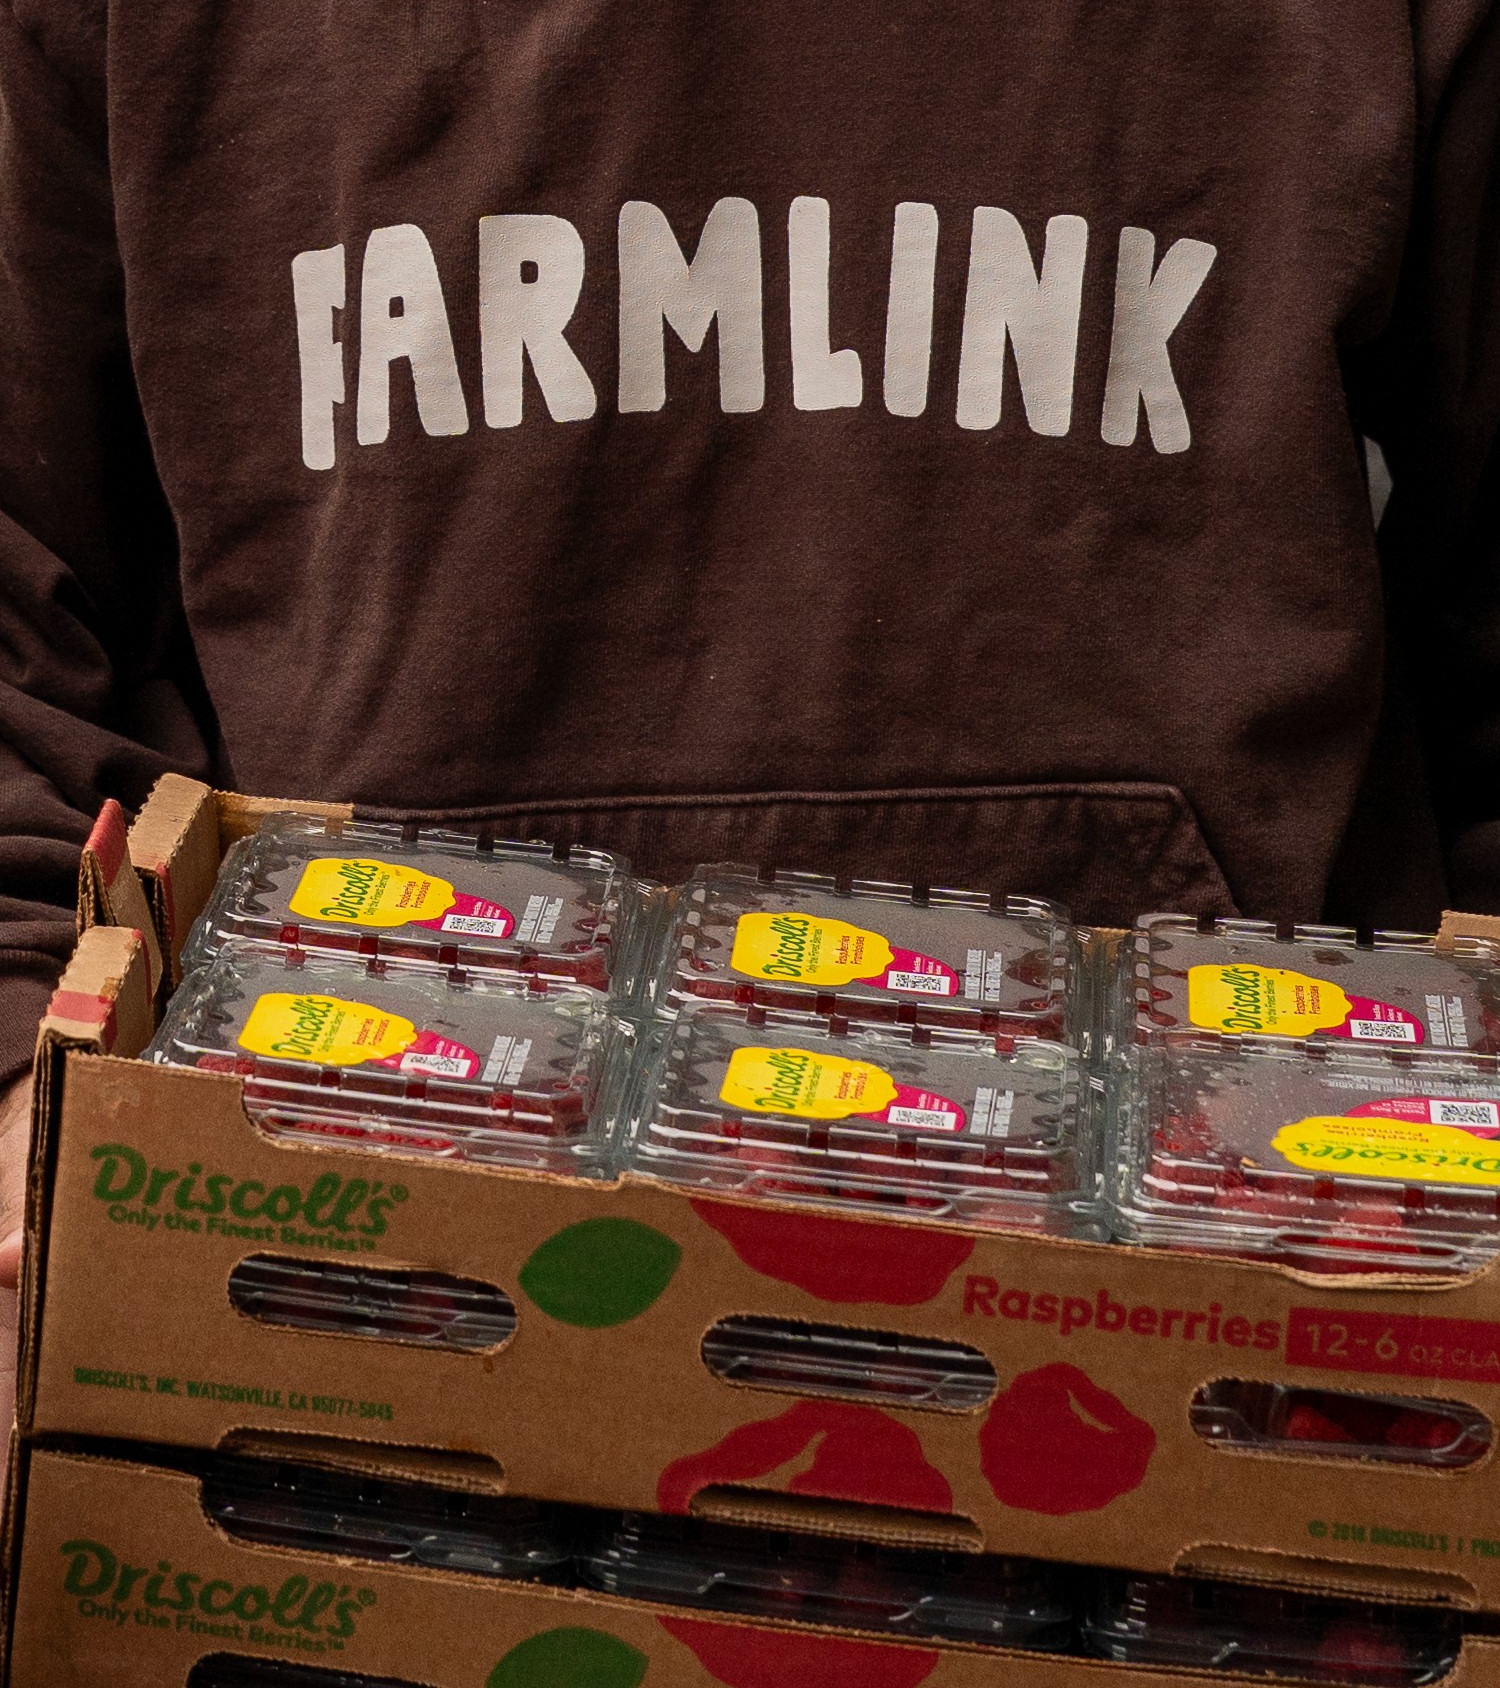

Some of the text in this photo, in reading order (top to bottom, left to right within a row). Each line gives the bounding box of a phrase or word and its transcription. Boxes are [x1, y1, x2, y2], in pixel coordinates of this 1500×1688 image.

[291, 195, 1219, 471] FARMLINK
[319, 861, 379, 918] Driscoll's
[762, 917, 810, 977] Driscoll's
[271, 996, 334, 1056] Driscoll's
[1220, 966, 1263, 1029] Driscoll's
[754, 1050, 810, 1109] Driscoll's
[107, 1203, 161, 1231] Only
[163, 1212, 201, 1233] the
[206, 1216, 276, 1243] Finest
[962, 1273, 1282, 1352] Raspberries
[1306, 1322, 1401, 1362] 12-6
[1410, 1344, 1445, 1366] OZ
[287, 1390, 309, 1411] CA
[77, 1598, 131, 1627] Only
[133, 1604, 171, 1629] the
[174, 1613, 244, 1642] Finest
